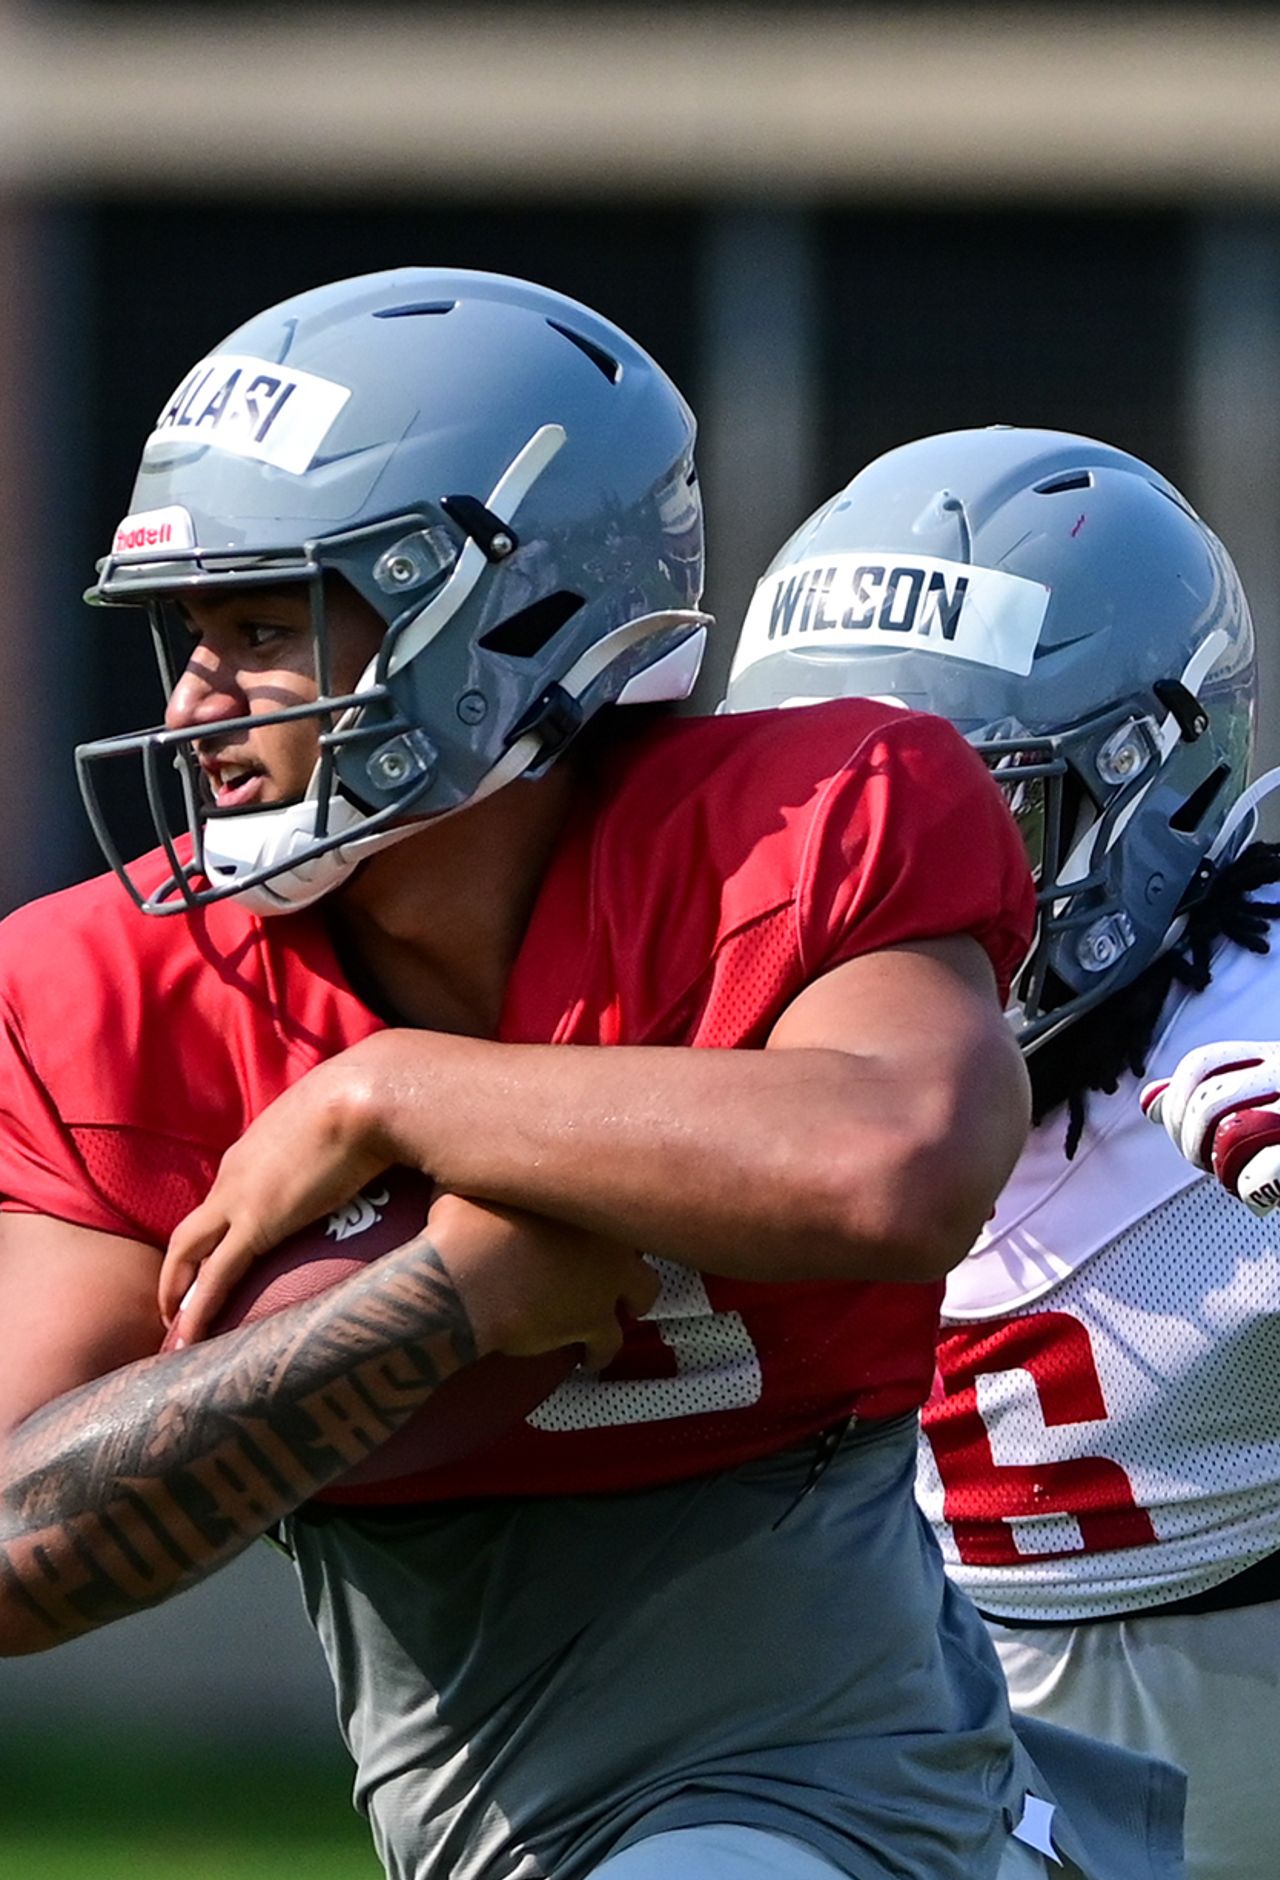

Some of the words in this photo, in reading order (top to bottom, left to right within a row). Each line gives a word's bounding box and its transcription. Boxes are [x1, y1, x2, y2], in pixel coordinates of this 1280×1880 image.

[156, 367, 297, 443] ALASI
[768, 566, 969, 641] WILSON
[922, 1311, 1160, 1566] 6
